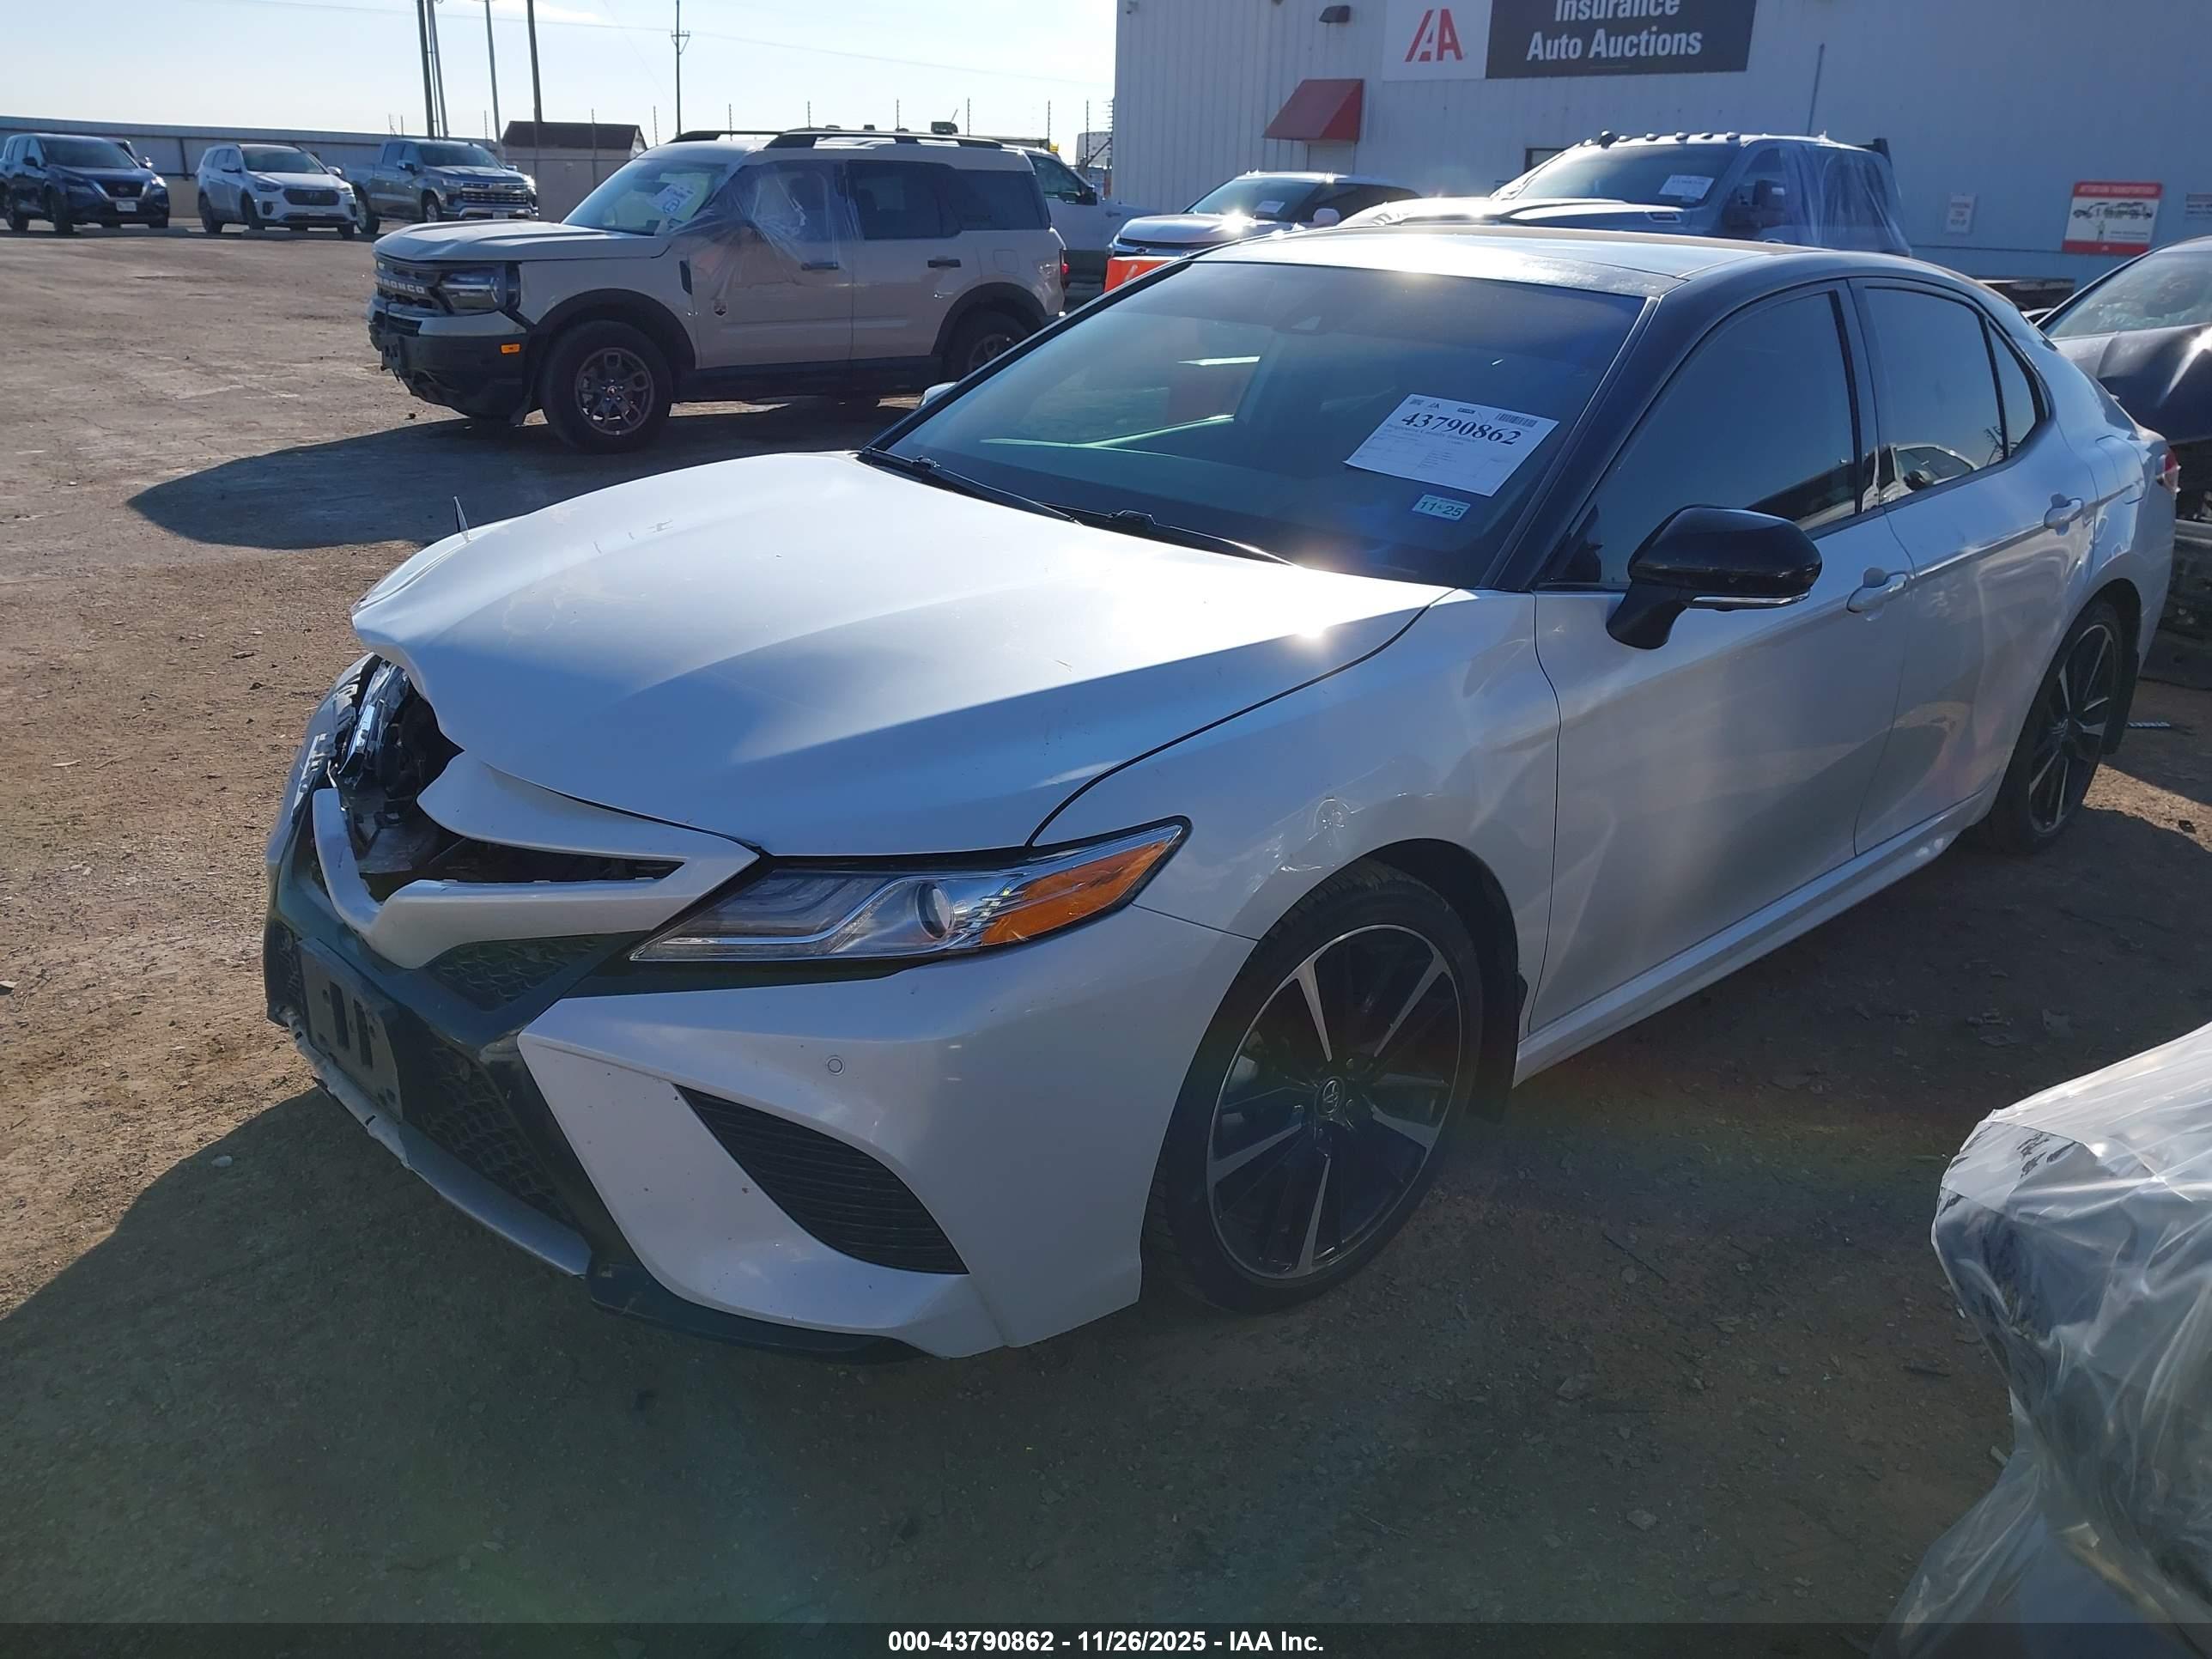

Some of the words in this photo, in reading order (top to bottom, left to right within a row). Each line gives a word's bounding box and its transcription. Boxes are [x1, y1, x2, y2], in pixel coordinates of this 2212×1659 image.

[1555, 0, 1680, 21] Insurance
[1526, 31, 1583, 61] Auto
[1588, 26, 1703, 58] Auctions
[1401, 412, 1522, 445] 43790862
